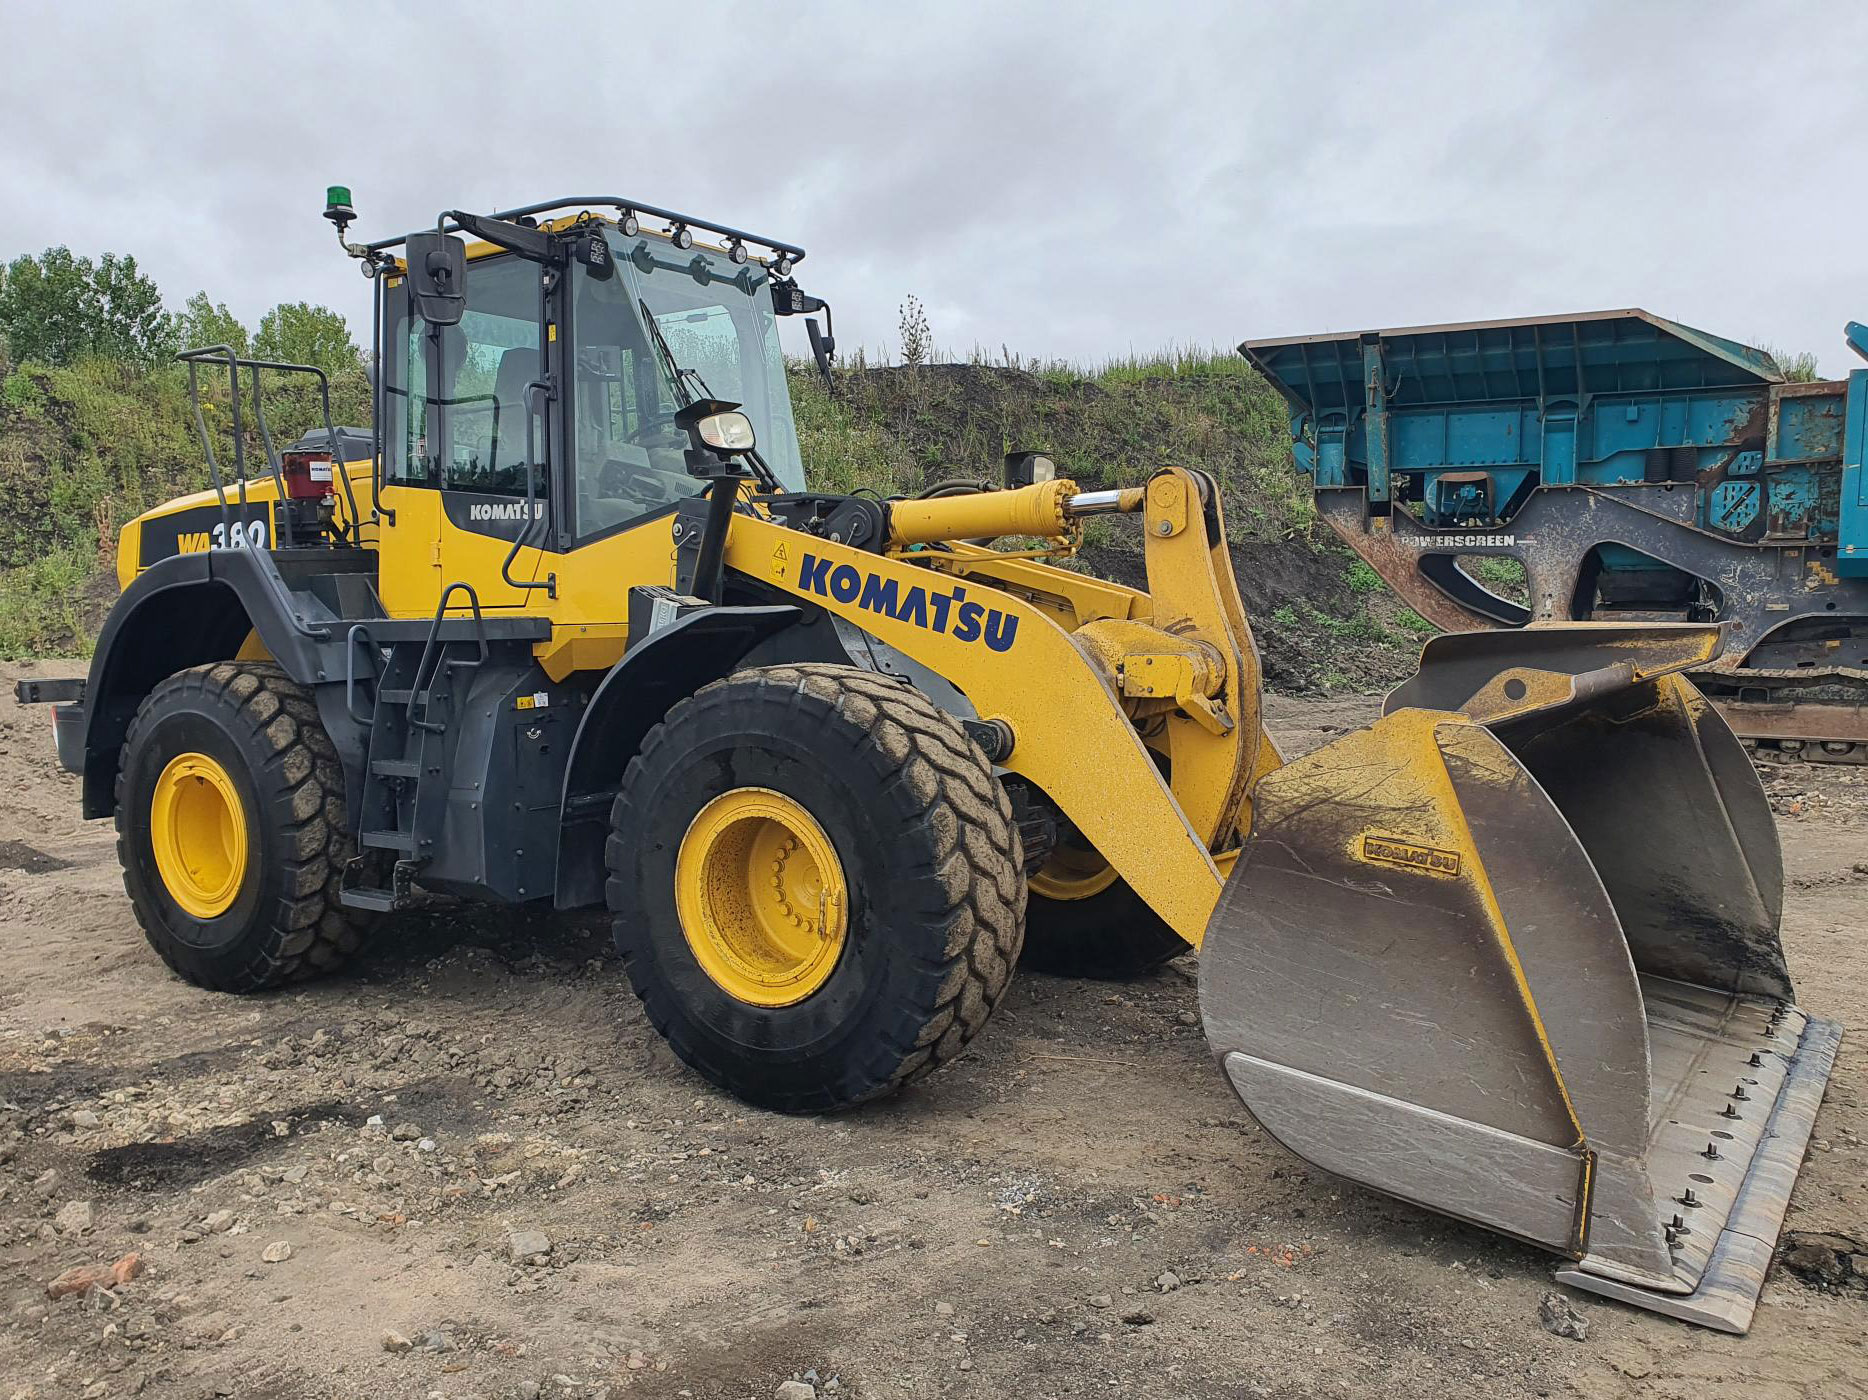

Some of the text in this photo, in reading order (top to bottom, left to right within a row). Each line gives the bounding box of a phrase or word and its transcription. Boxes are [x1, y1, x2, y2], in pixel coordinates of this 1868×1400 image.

[1401, 534, 1515, 547] POWERSCREEN
[798, 553, 1020, 653] KOMATSU
[1365, 842, 1457, 871] KOMATSU
